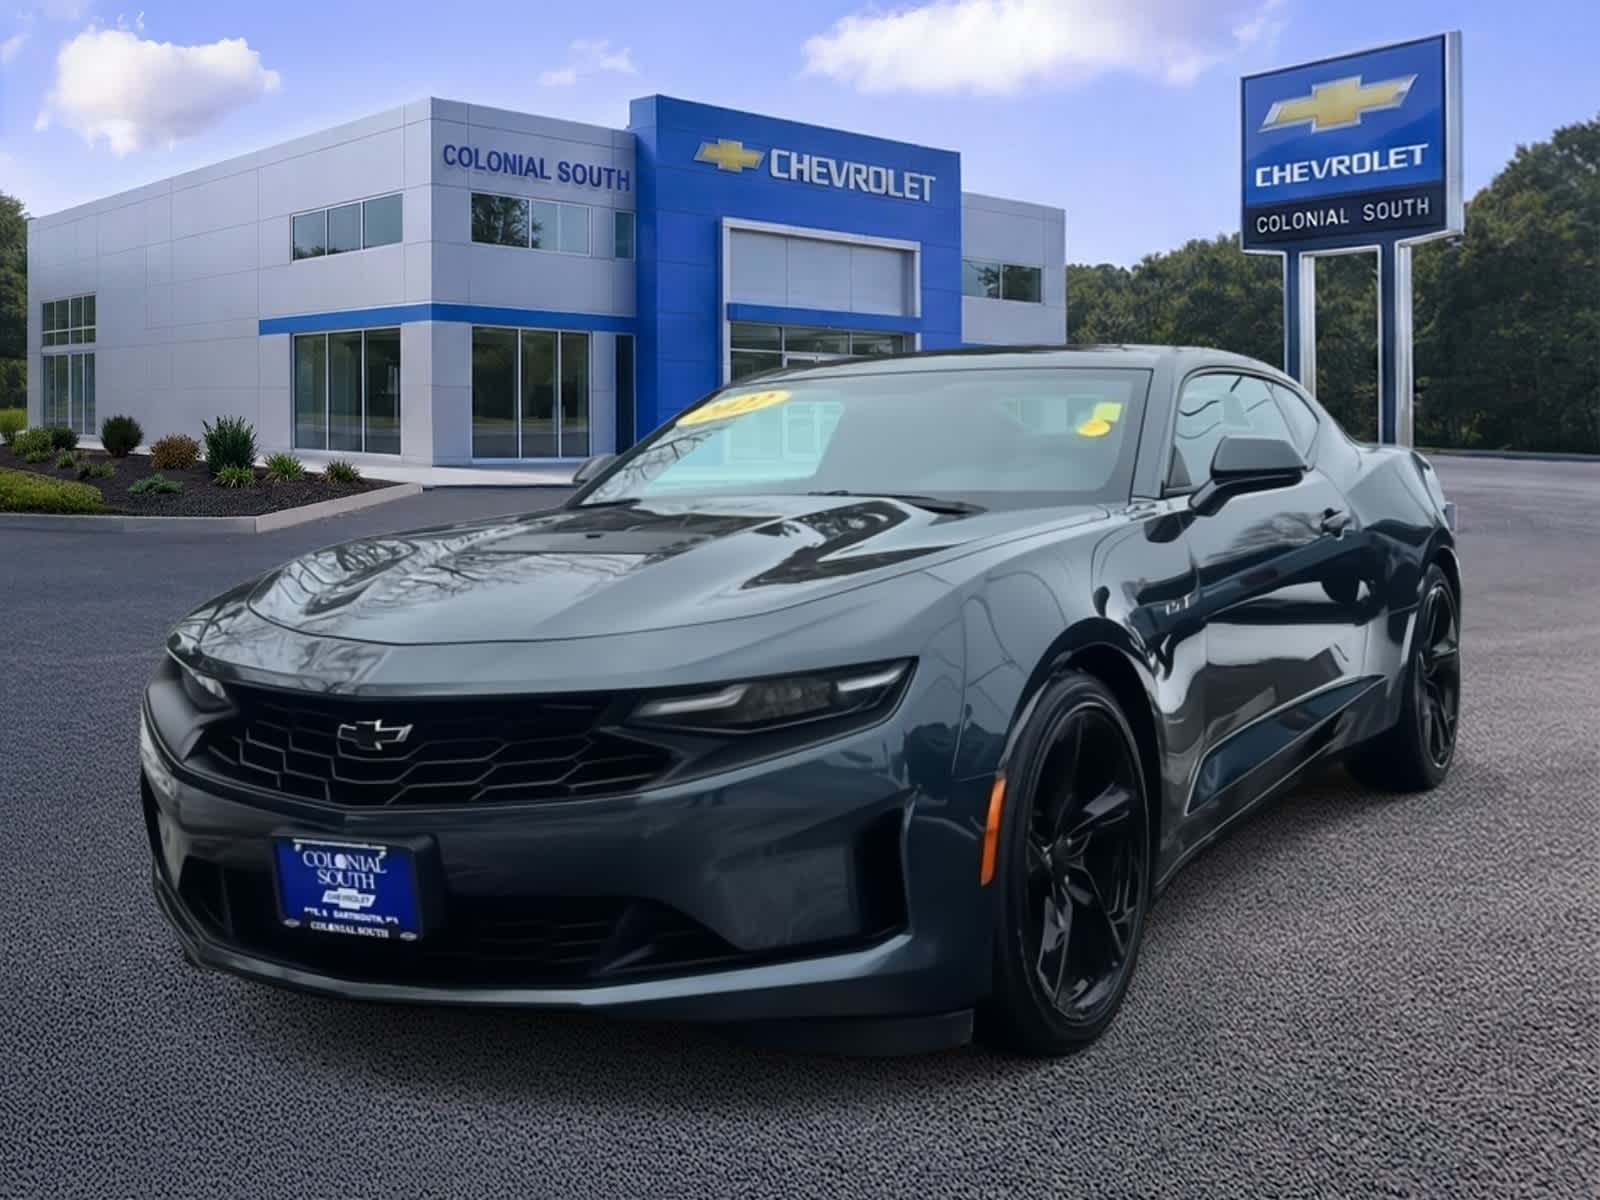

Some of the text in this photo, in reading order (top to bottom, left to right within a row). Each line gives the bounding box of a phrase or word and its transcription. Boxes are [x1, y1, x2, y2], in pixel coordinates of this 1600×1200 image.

[442, 143, 632, 193] COLONIAL SOUTH
[769, 148, 936, 202] CHEVROLET
[1255, 143, 1429, 187] CHEVROLET
[1256, 196, 1430, 234] COLONIAL SOUTH
[302, 850, 388, 874] COLONIAL
[317, 868, 376, 890] SOUTH
[310, 920, 390, 939] COLONIAL SOUTH
